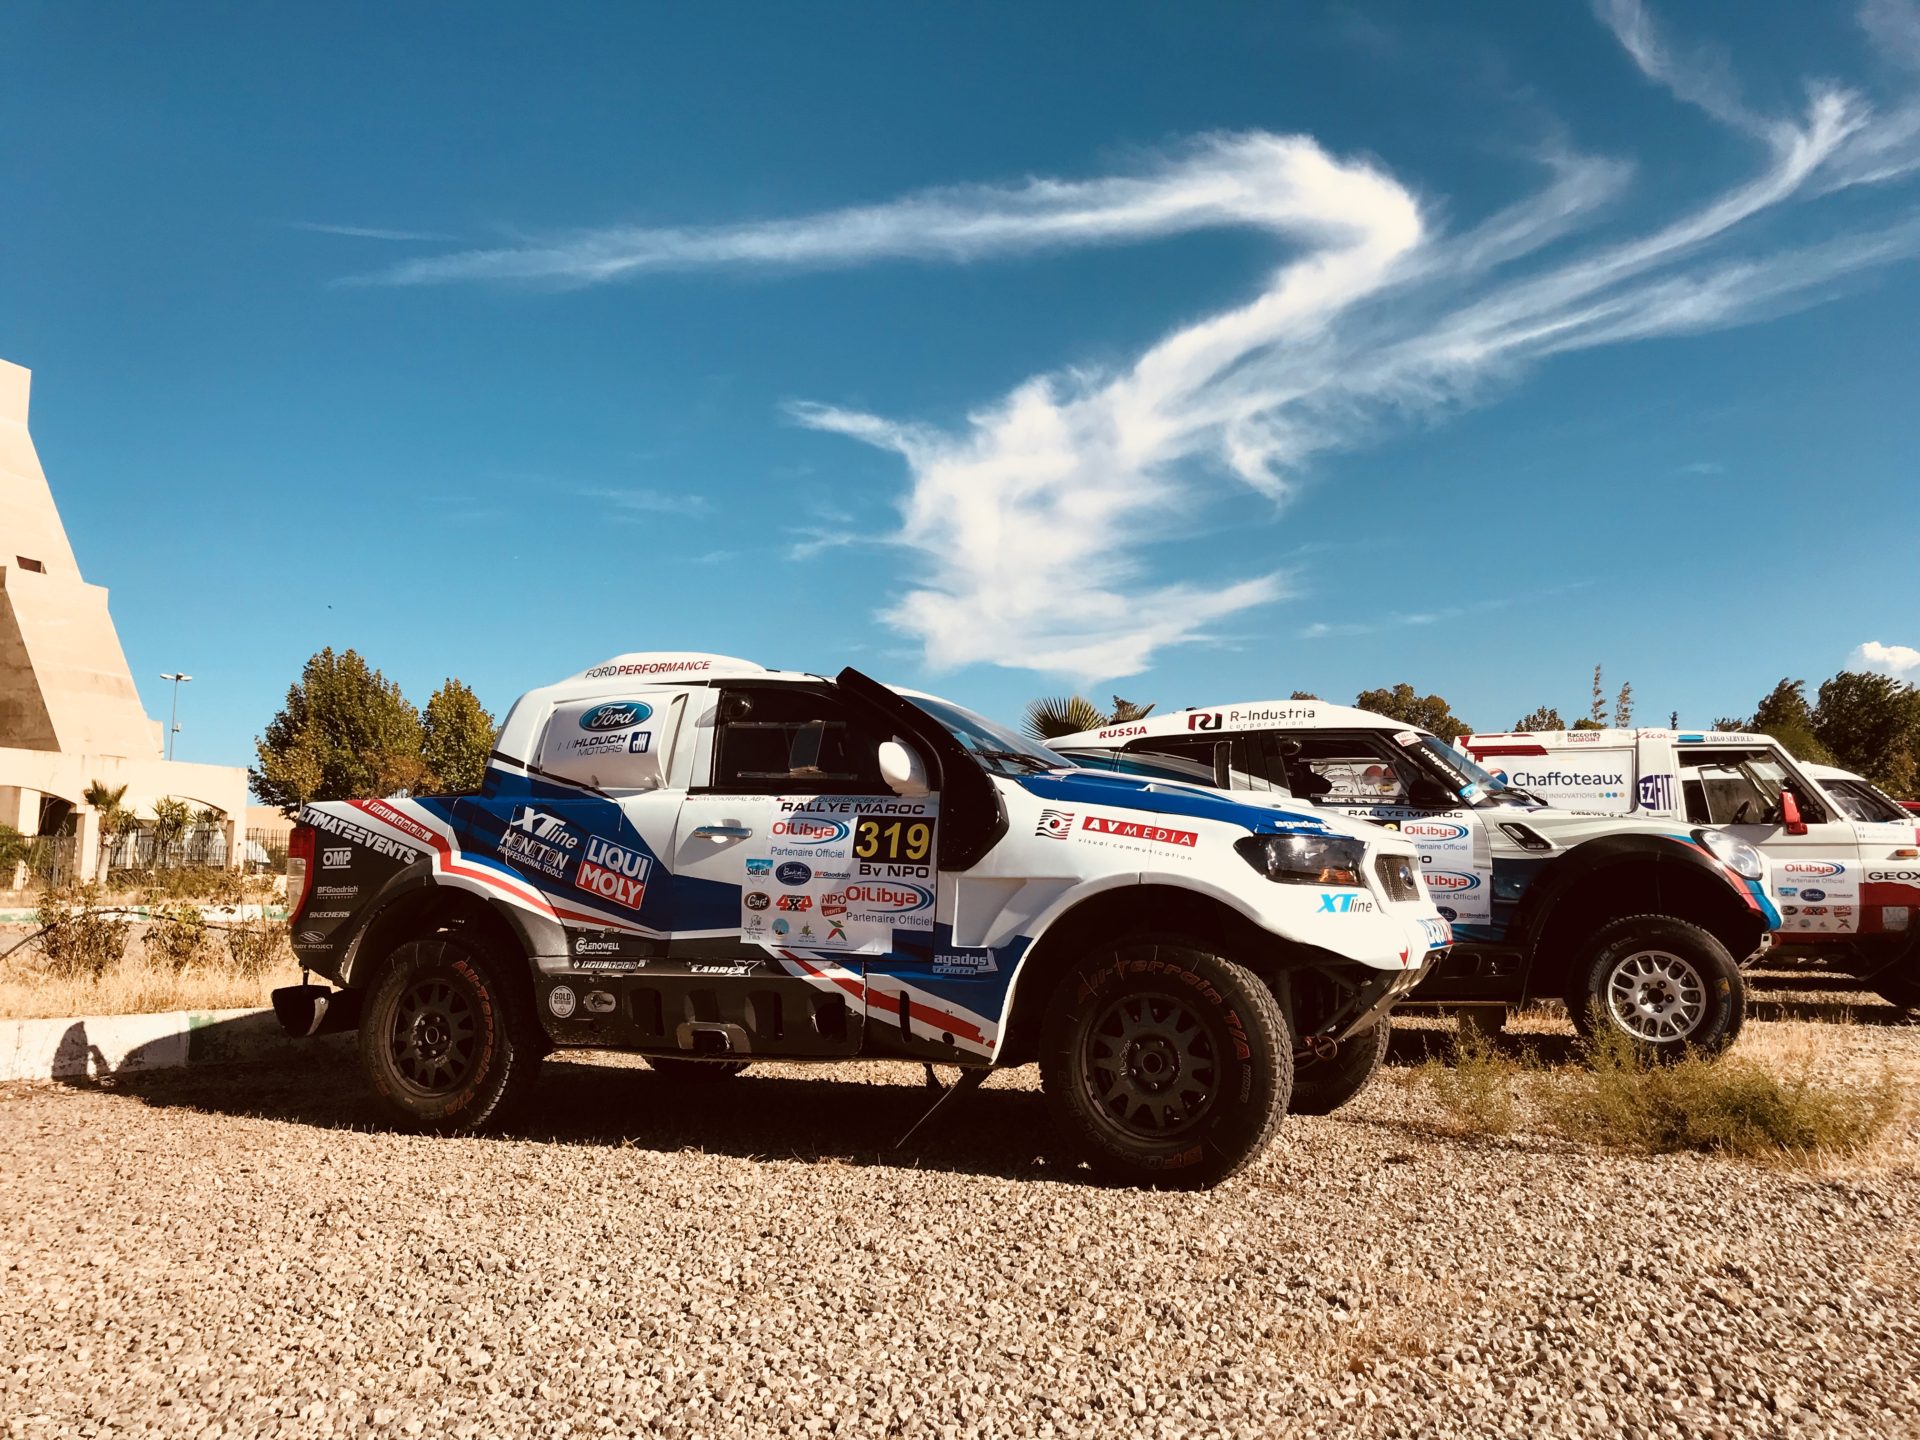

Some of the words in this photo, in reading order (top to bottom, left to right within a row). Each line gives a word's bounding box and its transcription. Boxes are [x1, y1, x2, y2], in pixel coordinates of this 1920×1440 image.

[585, 665, 617, 679] FORD
[617, 660, 712, 676] PERFORMANCE
[591, 703, 638, 728] Ford
[1230, 708, 1316, 722] R-Industria
[1099, 725, 1148, 739] RUSSIA
[1229, 720, 1304, 730] corporation
[574, 734, 628, 749] HLOUCH
[1726, 735, 1755, 743] SERVICES
[577, 744, 623, 756] MOTORS
[1512, 771, 1623, 787] Chaffoteaux
[780, 802, 852, 813] RALLYE
[854, 803, 925, 815] MAROC
[1347, 809, 1404, 818] RALLYE
[1407, 810, 1464, 819] MAROC
[772, 821, 835, 839] OiLibya
[1404, 823, 1456, 838] OiLibya
[856, 821, 930, 860] 319
[1443, 843, 1468, 851] Officiel
[500, 829, 570, 870] HONITON
[770, 847, 814, 858] Partenaire
[815, 847, 846, 859] Officiel
[1078, 838, 1109, 847] visual
[1113, 843, 1193, 861] communication
[322, 850, 352, 866] OMP
[496, 845, 542, 870] PROFESSIONAL
[542, 865, 564, 879] TOOLS
[586, 839, 649, 881] LIQUI
[814, 870, 851, 878] BFGoodrich
[859, 863, 882, 877] Bv
[887, 865, 929, 879] NPO
[1784, 863, 1834, 874] OiLibya
[579, 864, 644, 905] MOLY
[1423, 875, 1468, 888] iLibya
[317, 885, 358, 894] BFGoodrich
[845, 885, 918, 906] OiLibya
[821, 893, 847, 905] NPO
[1316, 893, 1373, 914] XTline
[1453, 893, 1480, 901] Officiel
[309, 911, 350, 919] SKECHERS
[846, 912, 895, 924] Partenaire
[898, 914, 934, 927] Officiel
[933, 953, 987, 966] agados
[554, 992, 571, 1001] GOLD
